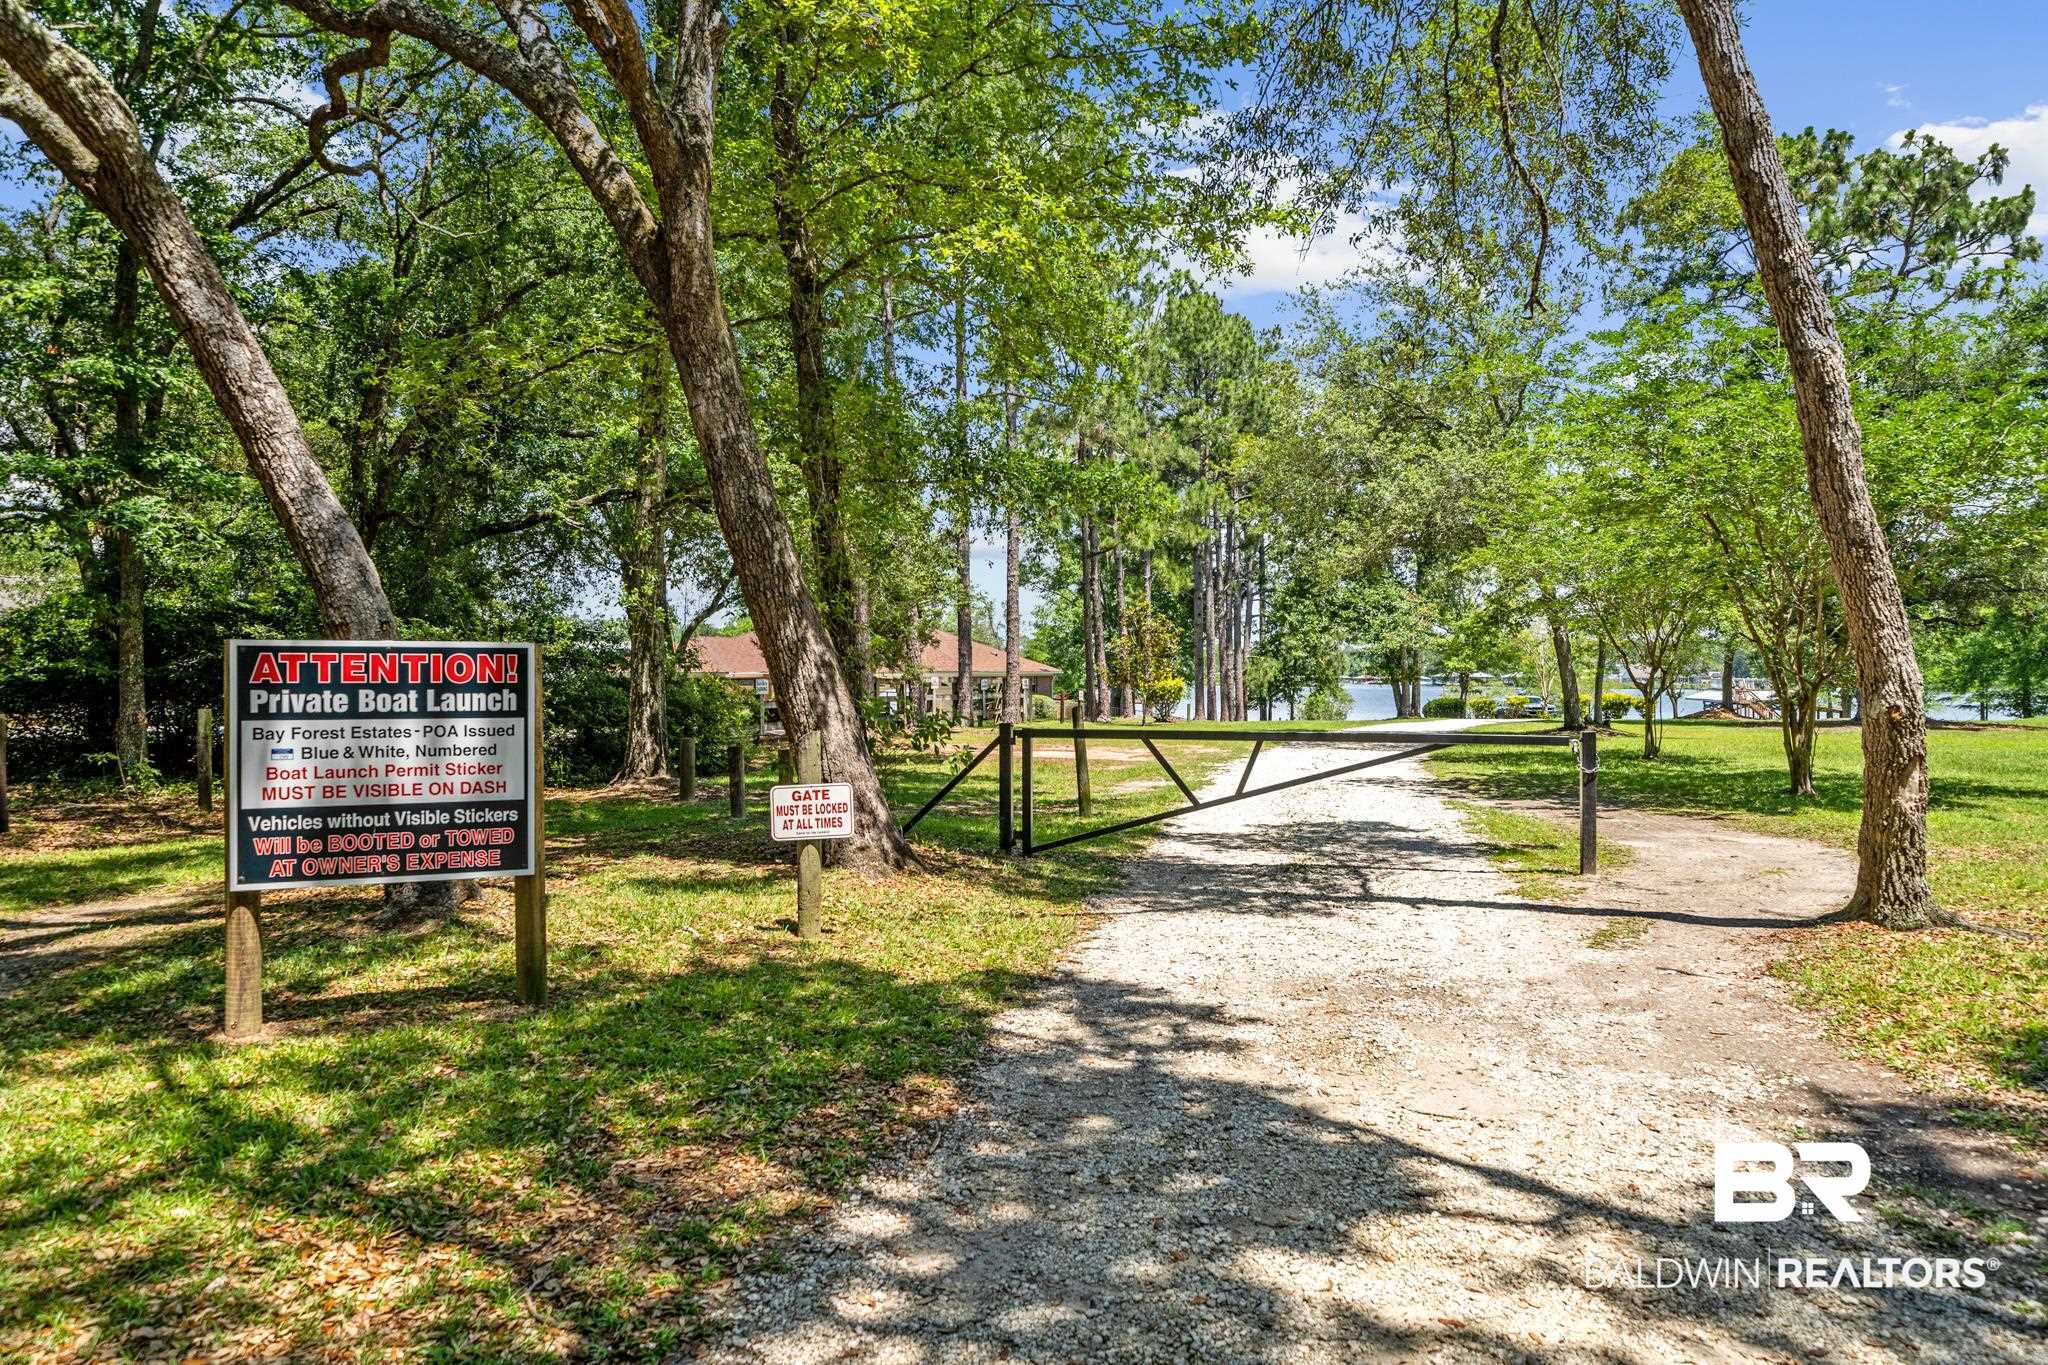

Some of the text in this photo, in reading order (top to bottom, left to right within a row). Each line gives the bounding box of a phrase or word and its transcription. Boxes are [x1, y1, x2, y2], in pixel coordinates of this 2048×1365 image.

[249, 652, 518, 685] ATTENTION!
[250, 689, 517, 713] Private Boat Launch
[253, 727, 284, 743] Bay
[292, 727, 345, 739] Forest
[464, 724, 515, 737] Issued
[301, 744, 497, 759] Blue & White, Numbered
[266, 763, 502, 781] Boat Launch Permit Sticker
[262, 781, 507, 800] MUST BE VISIBLE ON DASH
[792, 790, 830, 801] GATE
[776, 803, 848, 816] MUST BE LOCKED
[248, 808, 518, 832] Vehicles without Visible Stickers
[783, 817, 842, 830] AT ALL TIMES
[253, 827, 515, 855] Will be BOOTED or TOWED
[269, 849, 501, 878] AT OWNER'S EXPENSE
